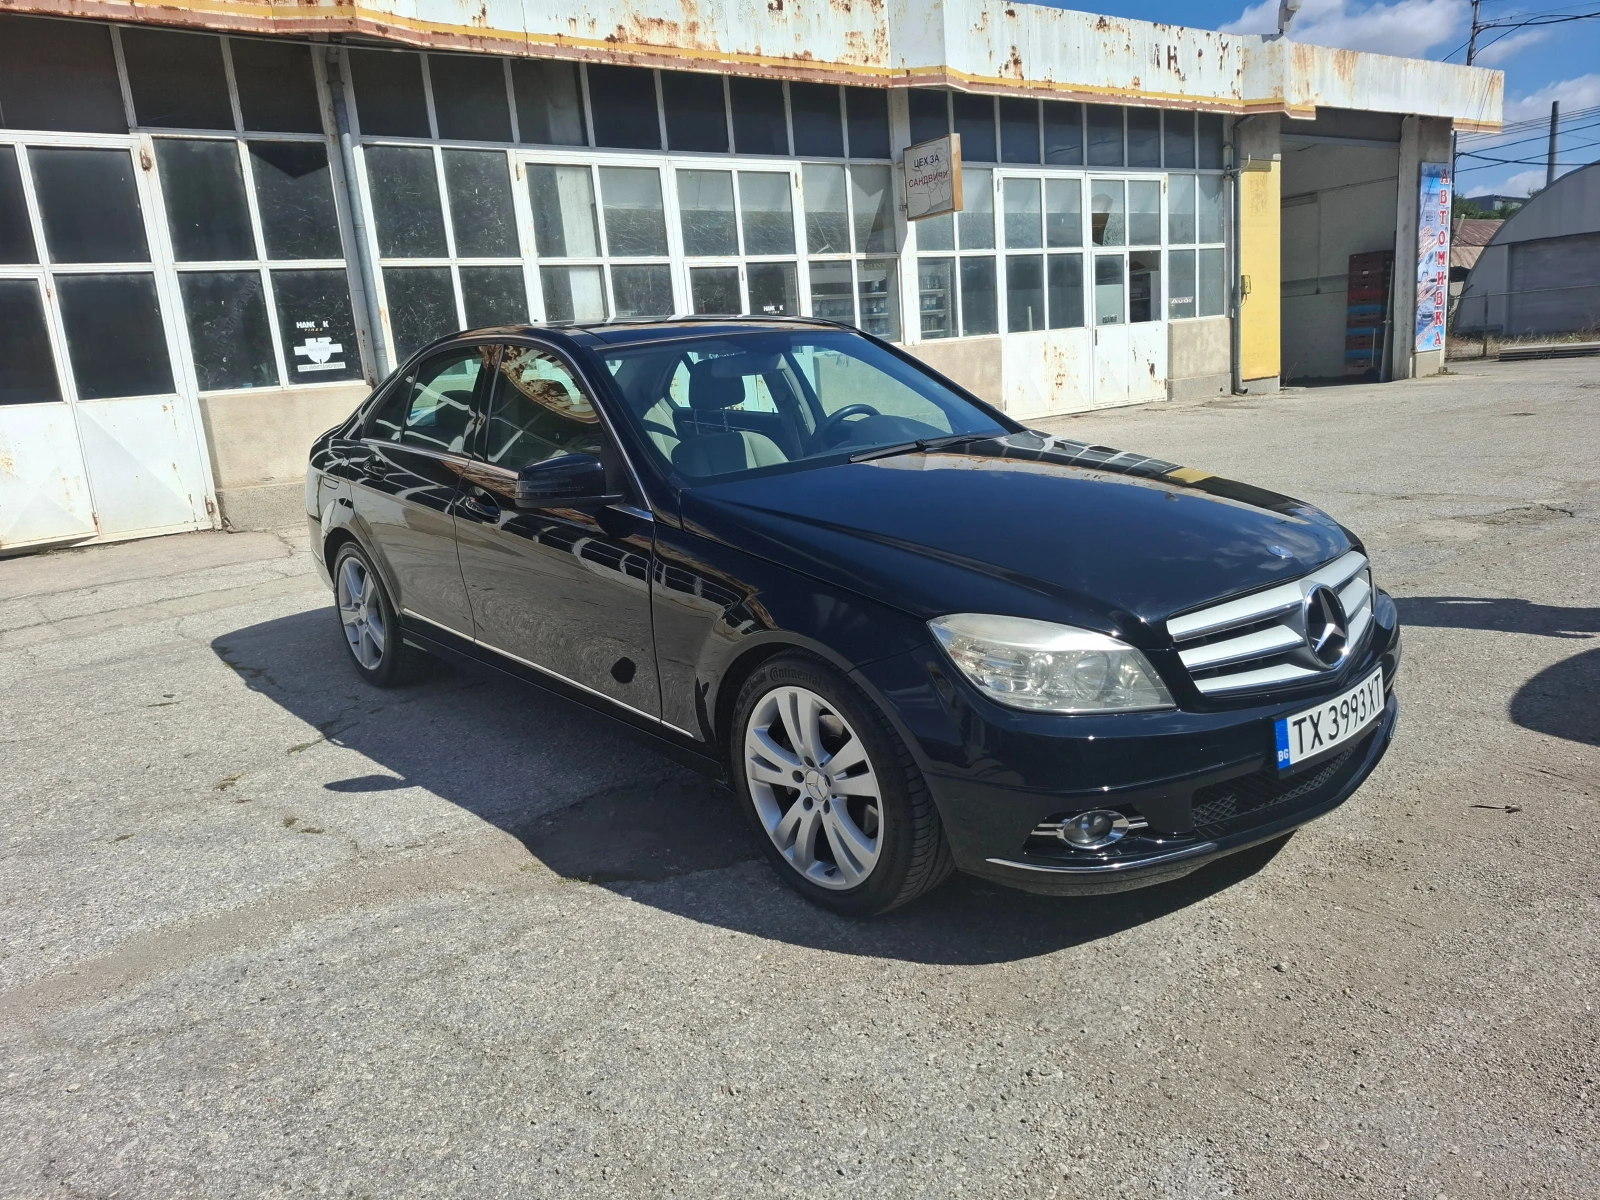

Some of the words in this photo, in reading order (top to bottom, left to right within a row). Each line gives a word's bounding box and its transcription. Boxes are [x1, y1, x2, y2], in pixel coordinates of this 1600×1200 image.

[914, 156, 928, 168] ЦЕХ
[929, 154, 939, 164] ЗА
[909, 171, 948, 188] САНДВИЧИ
[1434, 167, 1450, 346] АВТОМИВКА
[1292, 710, 1324, 755] TX
[1328, 687, 1367, 741] 3993
[1277, 748, 1289, 762] BG
